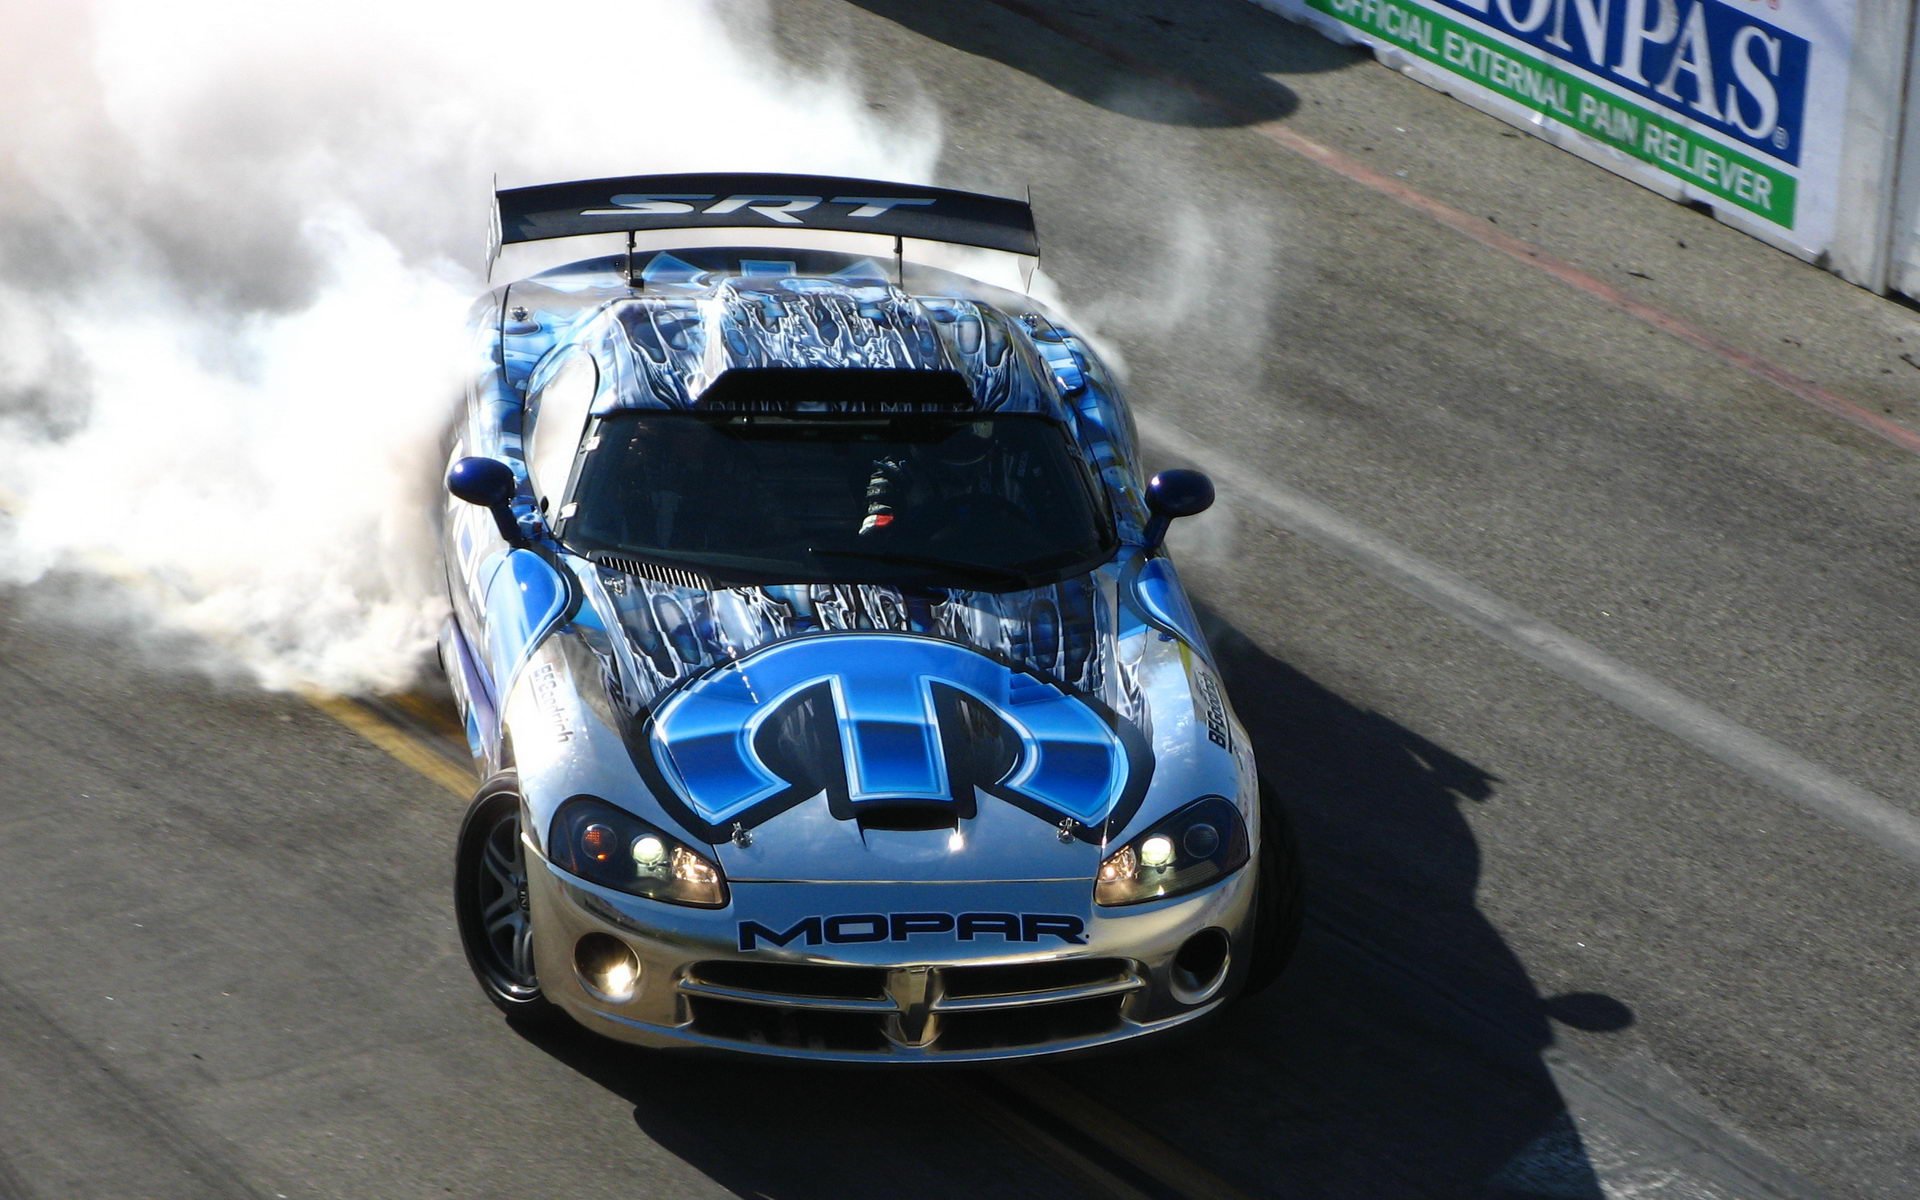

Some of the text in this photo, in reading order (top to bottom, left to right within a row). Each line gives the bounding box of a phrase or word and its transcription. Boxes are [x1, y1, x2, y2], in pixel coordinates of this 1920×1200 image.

[1443, 29, 1574, 118] EXTERNAL
[1578, 92, 1638, 146] PAIN
[1643, 122, 1772, 210] RELIEVER
[579, 194, 937, 224] SRT
[738, 912, 1088, 951] MOPAR
